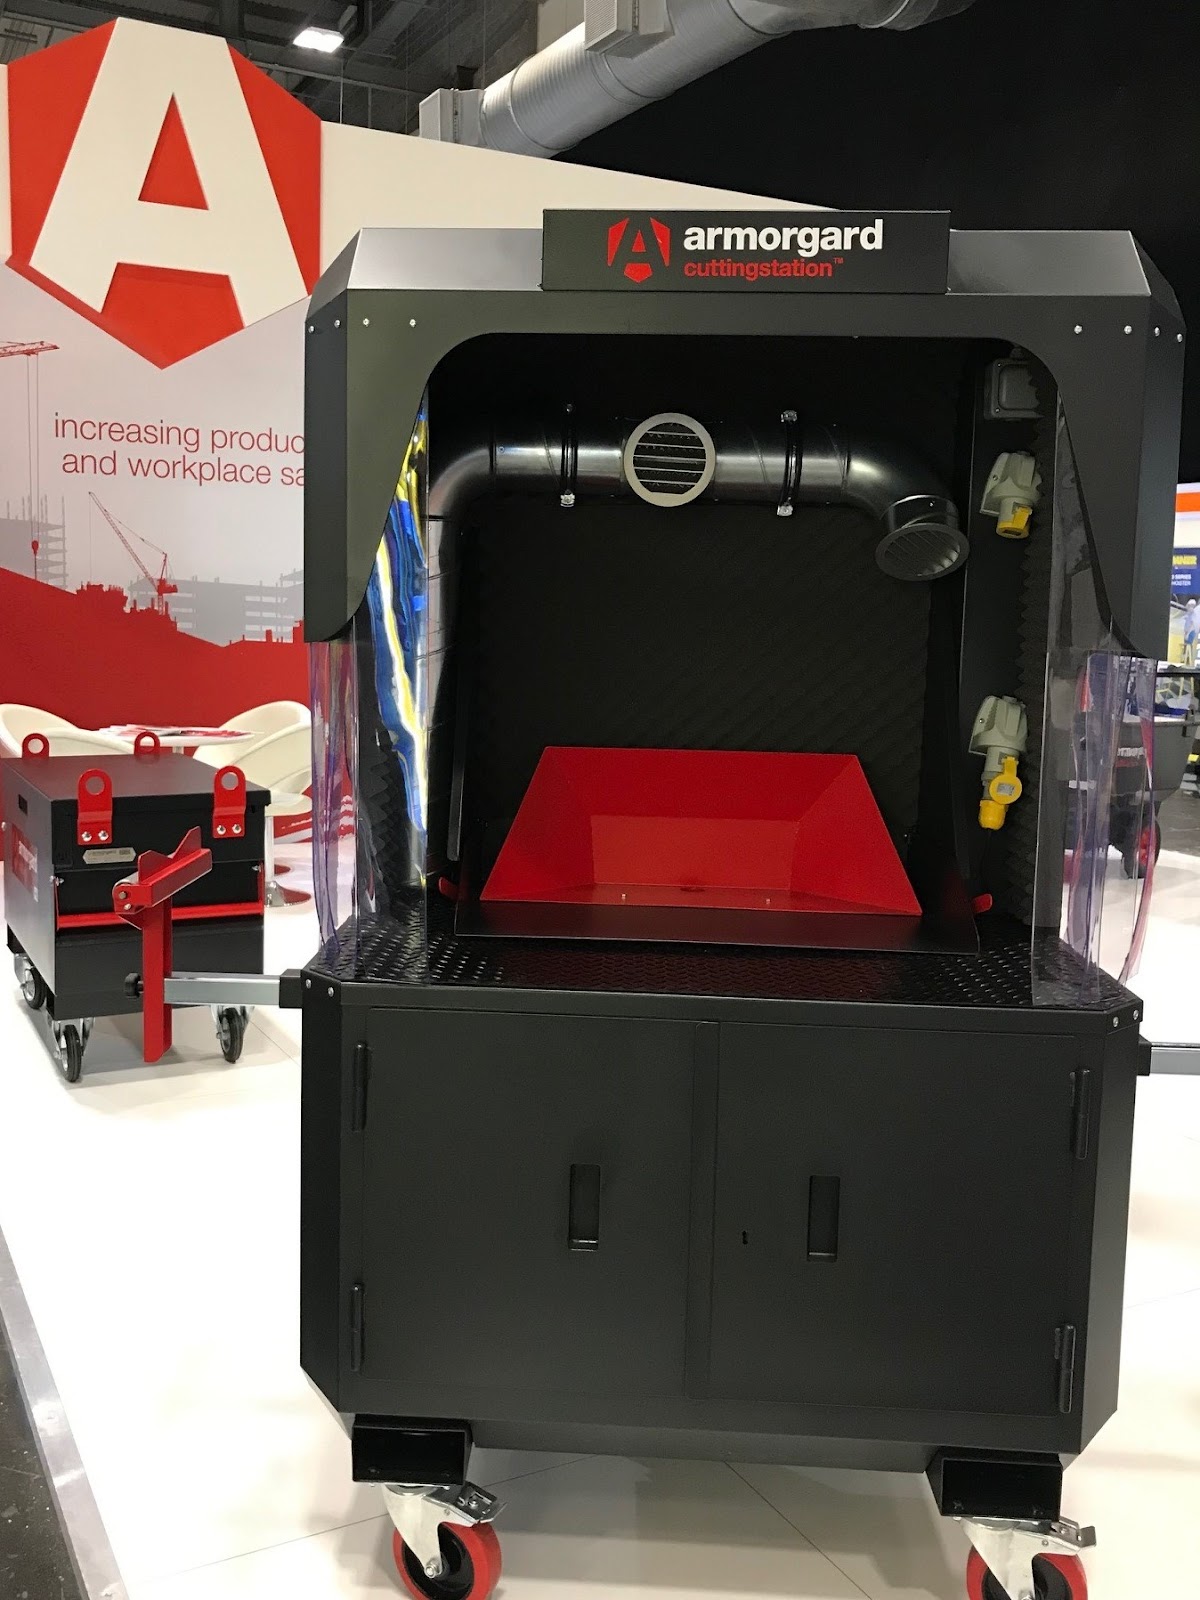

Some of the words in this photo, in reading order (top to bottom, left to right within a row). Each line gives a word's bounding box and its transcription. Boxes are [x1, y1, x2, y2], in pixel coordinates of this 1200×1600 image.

[683, 218, 884, 258] armorgard
[54, 411, 200, 453] increasing
[62, 450, 117, 476] and
[127, 454, 272, 487] workplace
